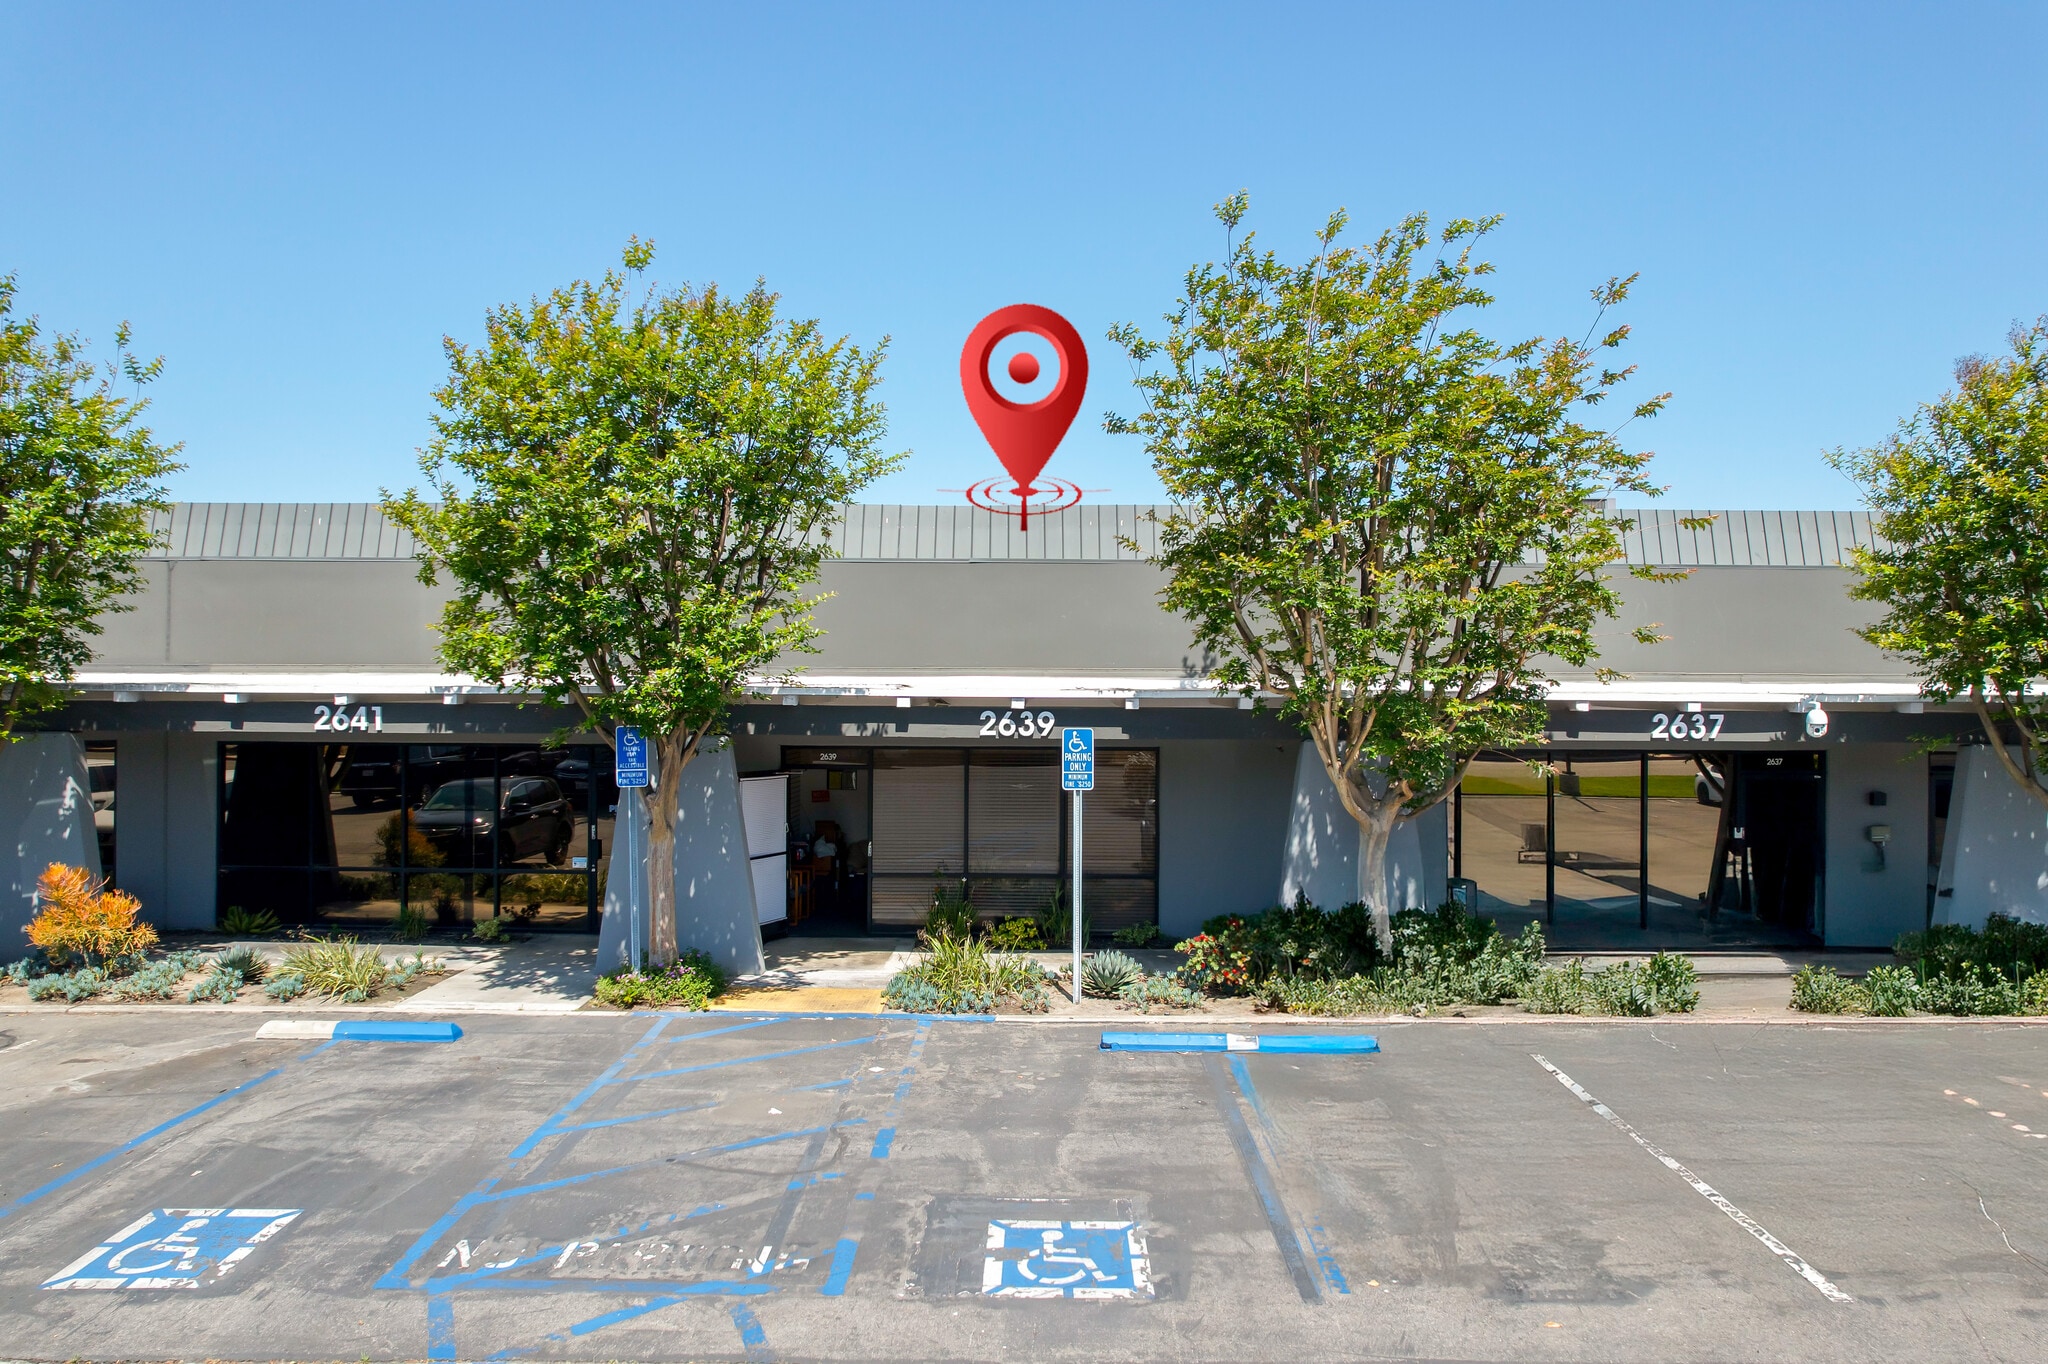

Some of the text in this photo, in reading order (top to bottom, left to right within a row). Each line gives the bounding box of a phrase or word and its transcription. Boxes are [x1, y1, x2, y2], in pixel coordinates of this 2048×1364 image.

[313, 705, 382, 731] 2641
[979, 710, 1055, 737] 2639
[1651, 713, 1725, 739] 2637
[1064, 752, 1092, 761] PARKING
[1766, 758, 1783, 766] 2637
[1070, 762, 1087, 771] ONLY
